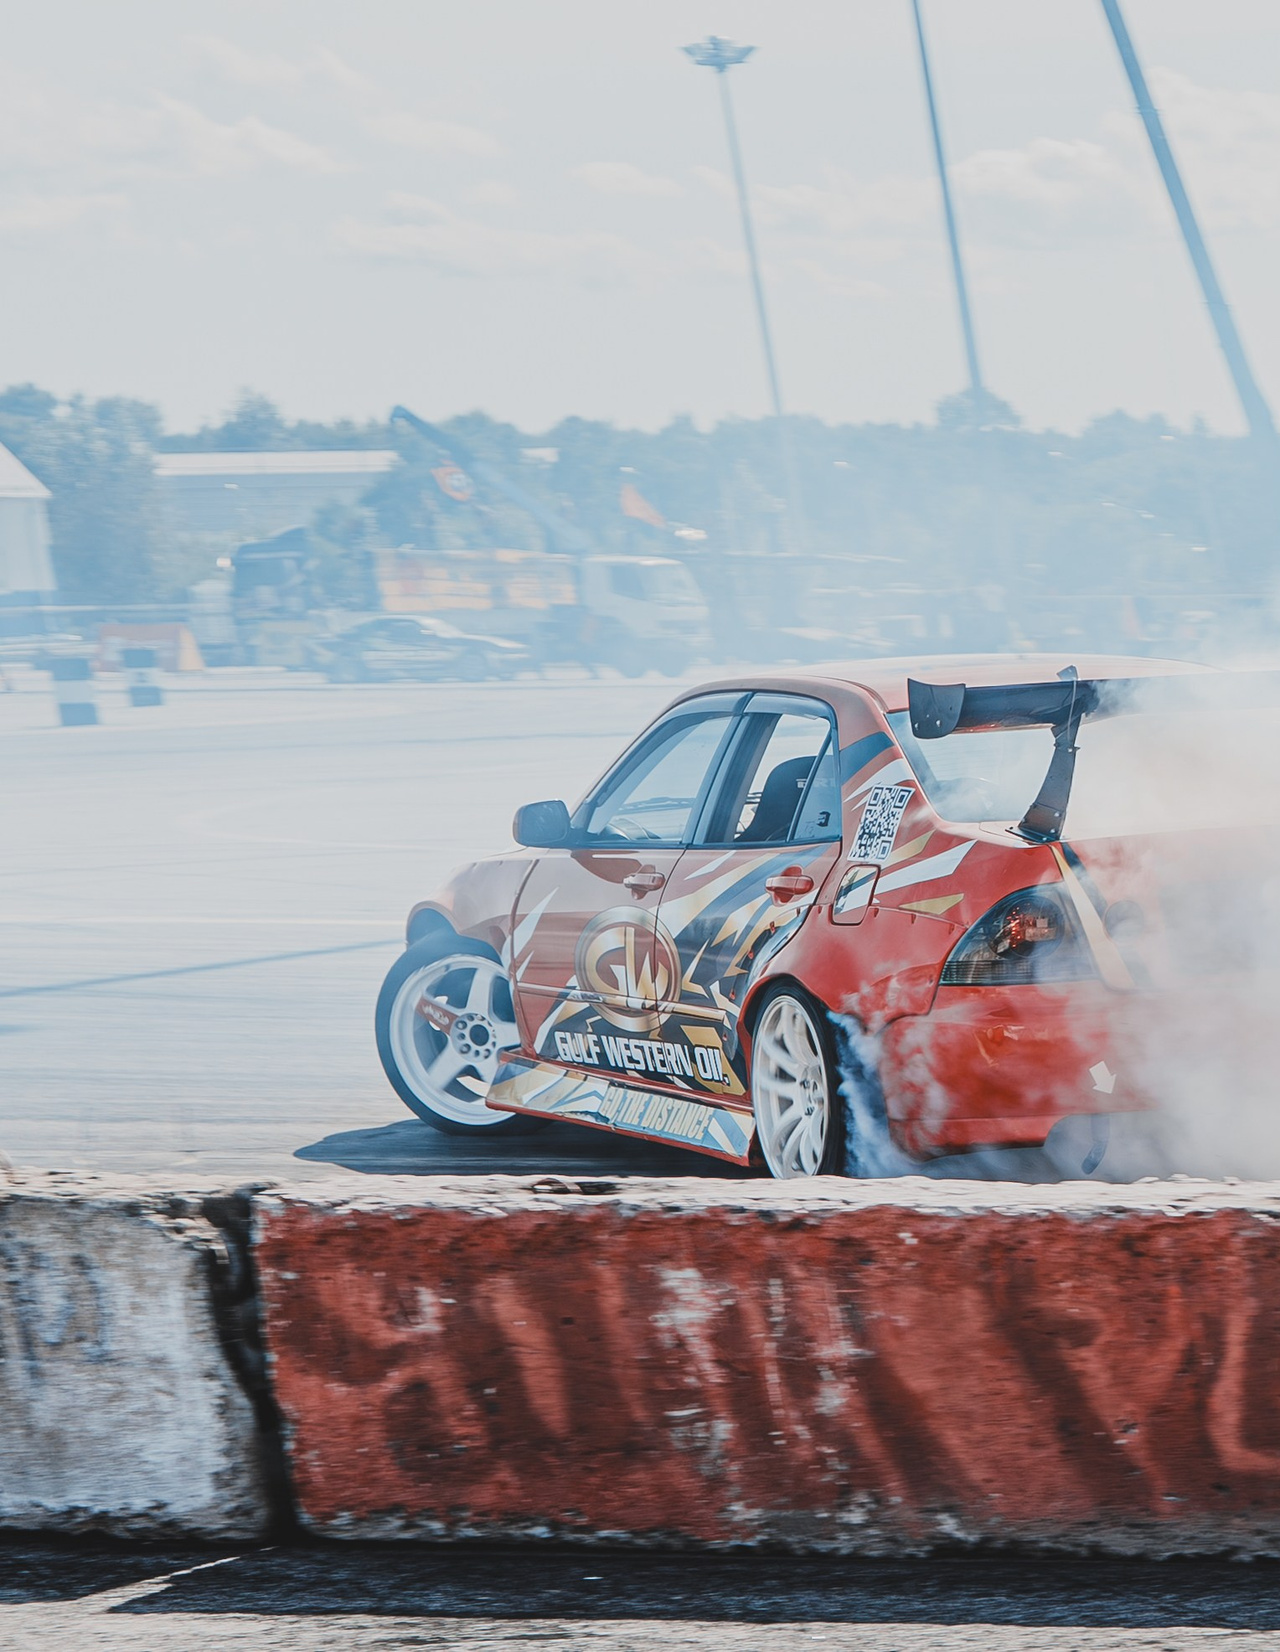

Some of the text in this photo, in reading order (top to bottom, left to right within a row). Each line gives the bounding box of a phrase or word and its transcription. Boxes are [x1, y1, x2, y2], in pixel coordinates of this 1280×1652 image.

[554, 1031, 729, 1083] GULF WESTERN OIL
[600, 1086, 714, 1140] GO THE DISTANCE
